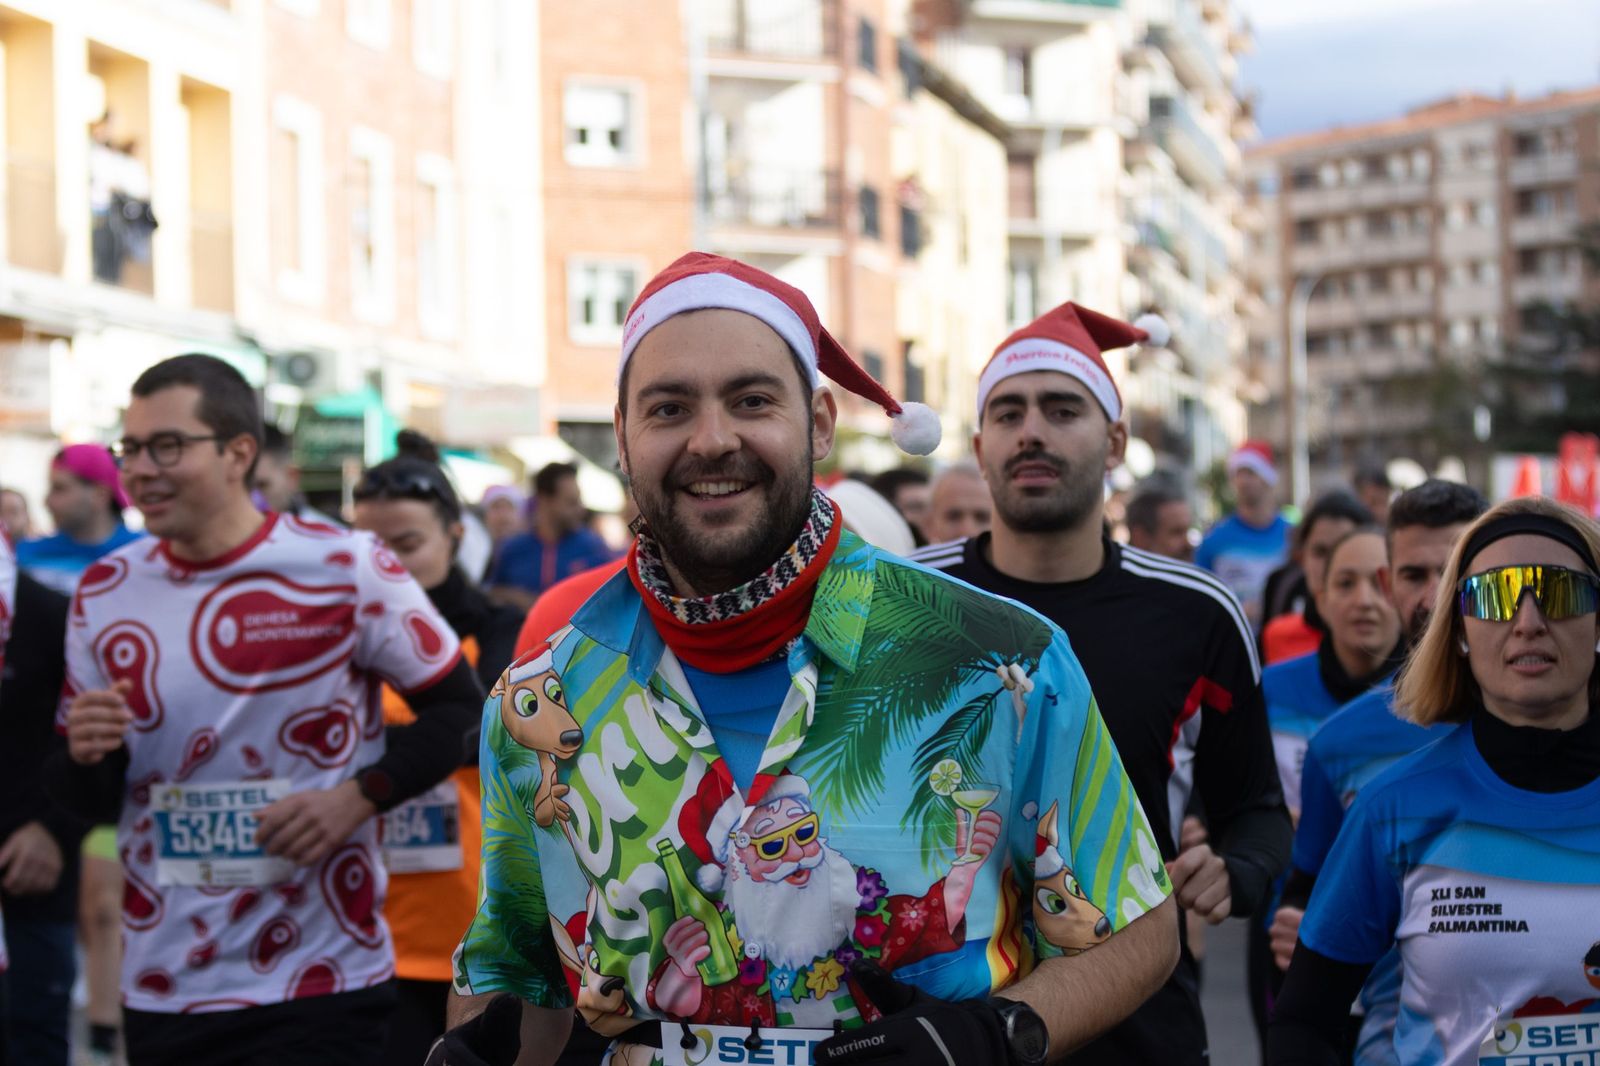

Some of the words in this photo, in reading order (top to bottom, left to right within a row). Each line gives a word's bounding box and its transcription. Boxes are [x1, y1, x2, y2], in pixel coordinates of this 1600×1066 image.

[243, 611, 299, 627] DEHESA
[185, 787, 277, 808] SETEL
[169, 811, 260, 854] 5346
[1431, 887, 1451, 901] XLI
[1455, 886, 1486, 899] SAN
[1431, 903, 1502, 917] SILVESTRE
[1428, 920, 1529, 933] SALMANTINA
[718, 1036, 820, 1066] SET
[827, 1033, 886, 1058] karrimor
